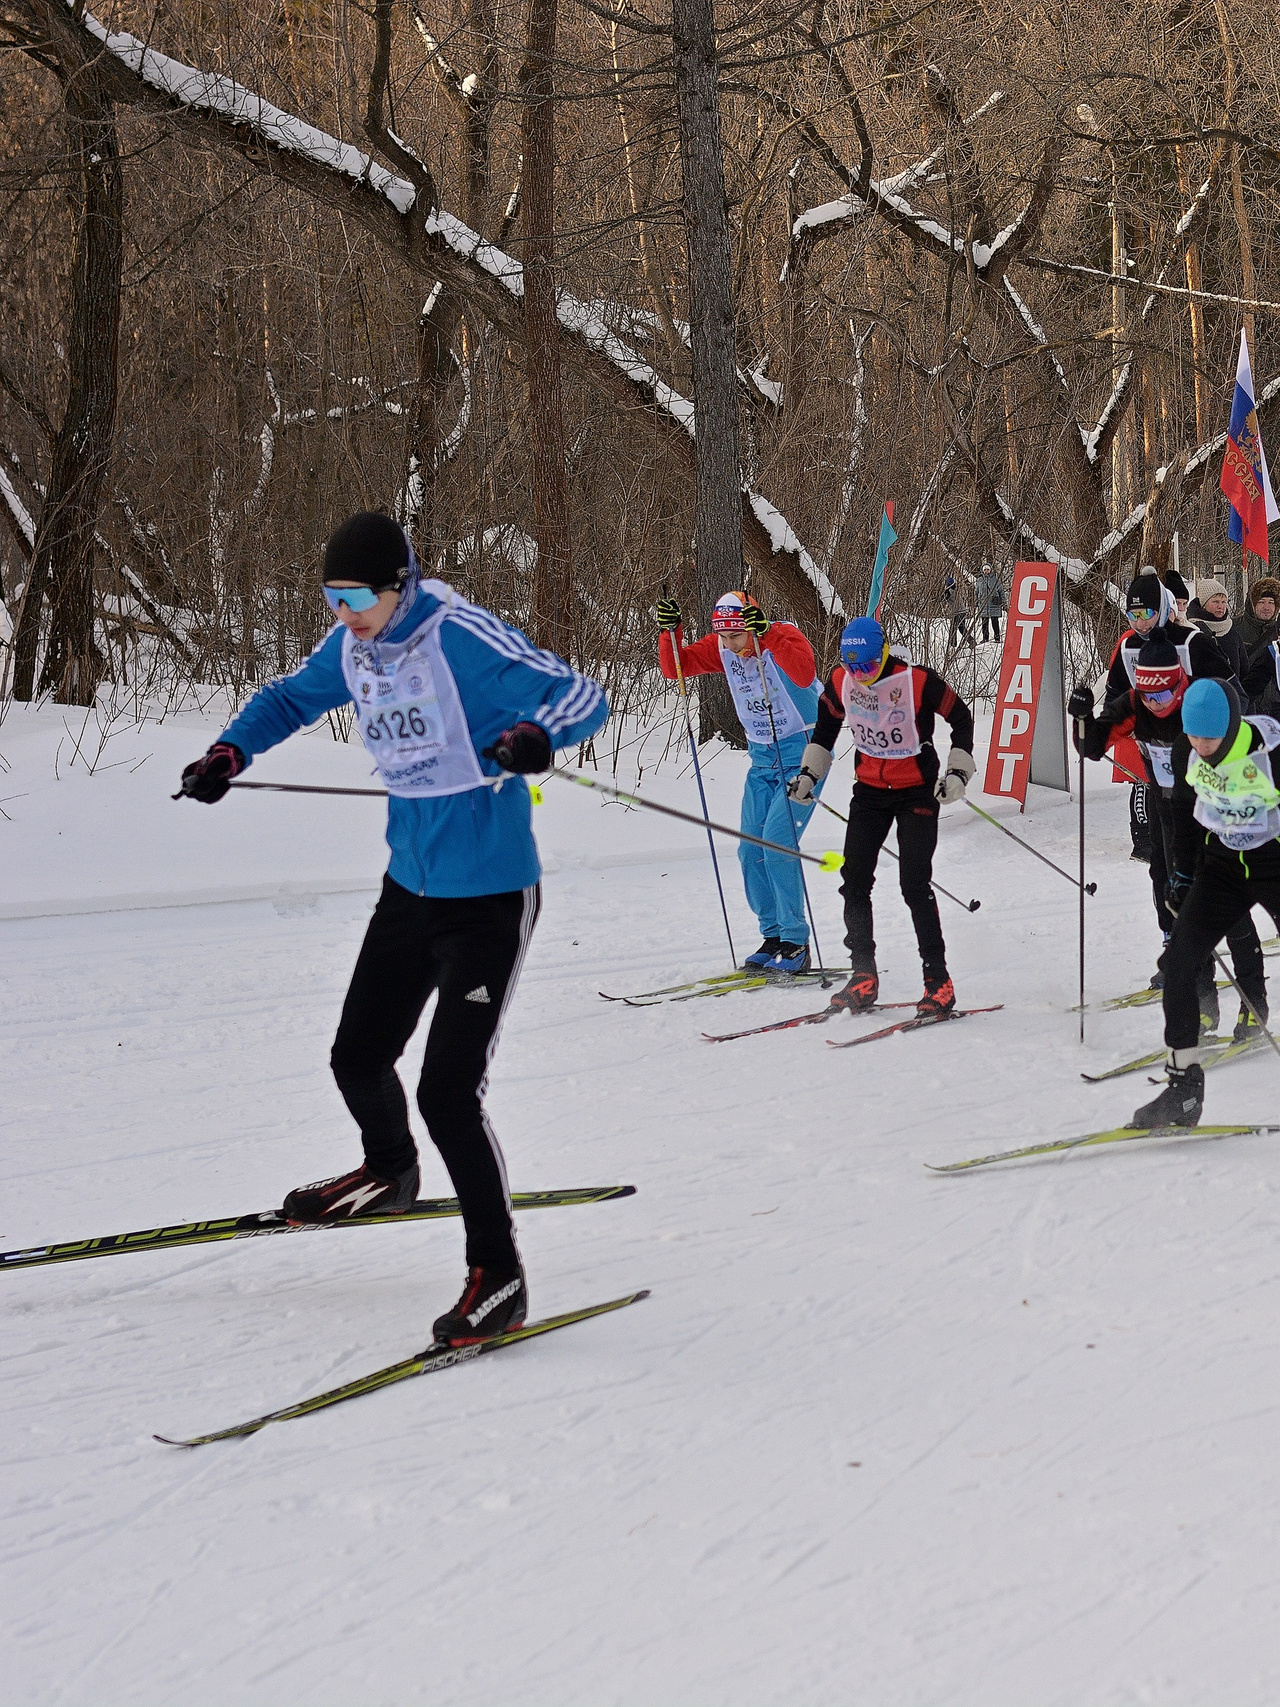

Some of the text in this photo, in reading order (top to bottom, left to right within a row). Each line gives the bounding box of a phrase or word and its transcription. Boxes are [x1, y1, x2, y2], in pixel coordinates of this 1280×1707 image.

[1225, 442, 1262, 504] ССИЯ
[997, 575, 1049, 792] СТАРТ
[1136, 673, 1171, 686] swix
[753, 718, 787, 728] САМАСКАЯ
[420, 1343, 483, 1374] FISCHER
